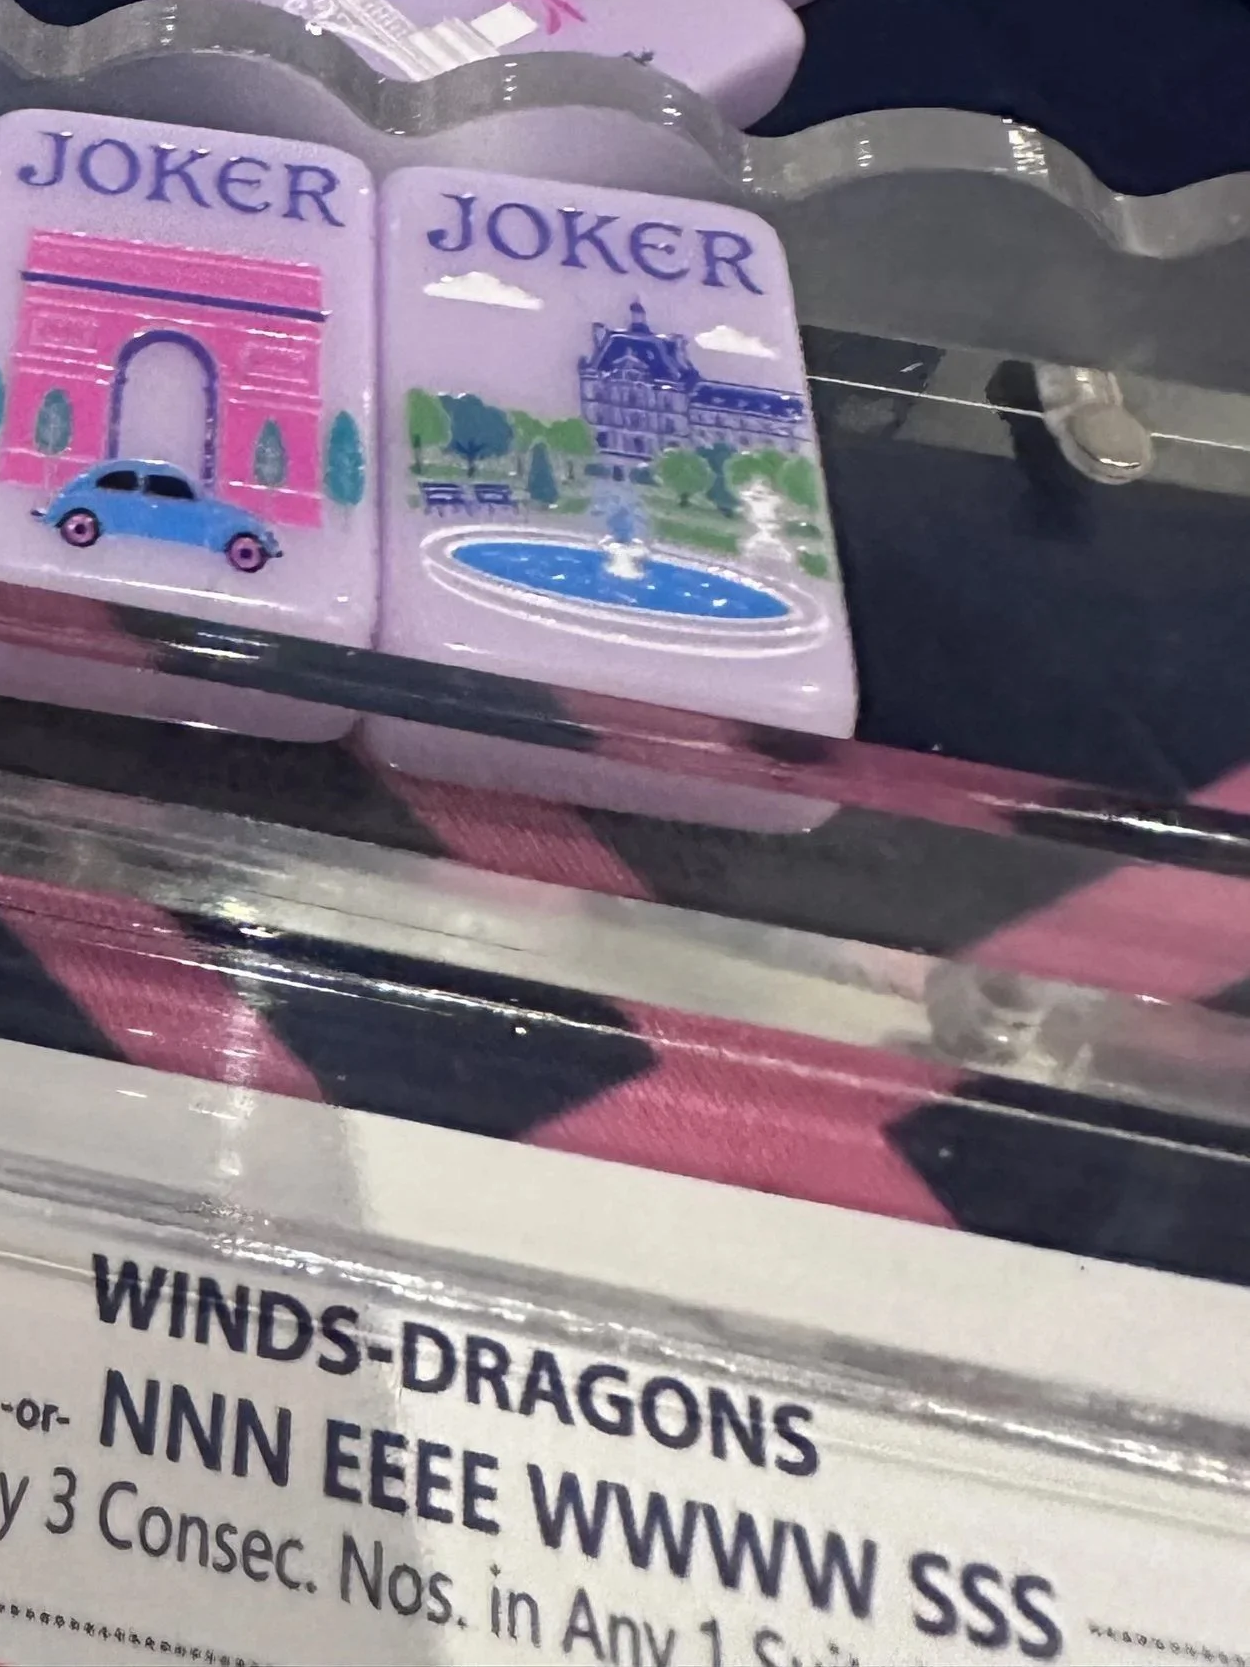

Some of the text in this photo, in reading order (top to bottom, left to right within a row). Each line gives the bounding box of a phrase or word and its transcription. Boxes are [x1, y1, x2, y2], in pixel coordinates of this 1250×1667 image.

[18, 132, 346, 228] JOKER
[427, 193, 764, 296] JOKER
[92, 1253, 820, 1478] WINDS-DRAGONS
[0, 1397, 70, 1435] -or-
[99, 1368, 291, 1487] NNN
[323, 1418, 501, 1536] EEEE
[526, 1462, 877, 1621] WWWW
[907, 1551, 1063, 1664] SSS
[45, 1467, 77, 1534] 3
[99, 1480, 317, 1594] Consec.
[340, 1532, 467, 1630] Nos.
[490, 1564, 540, 1648] in
